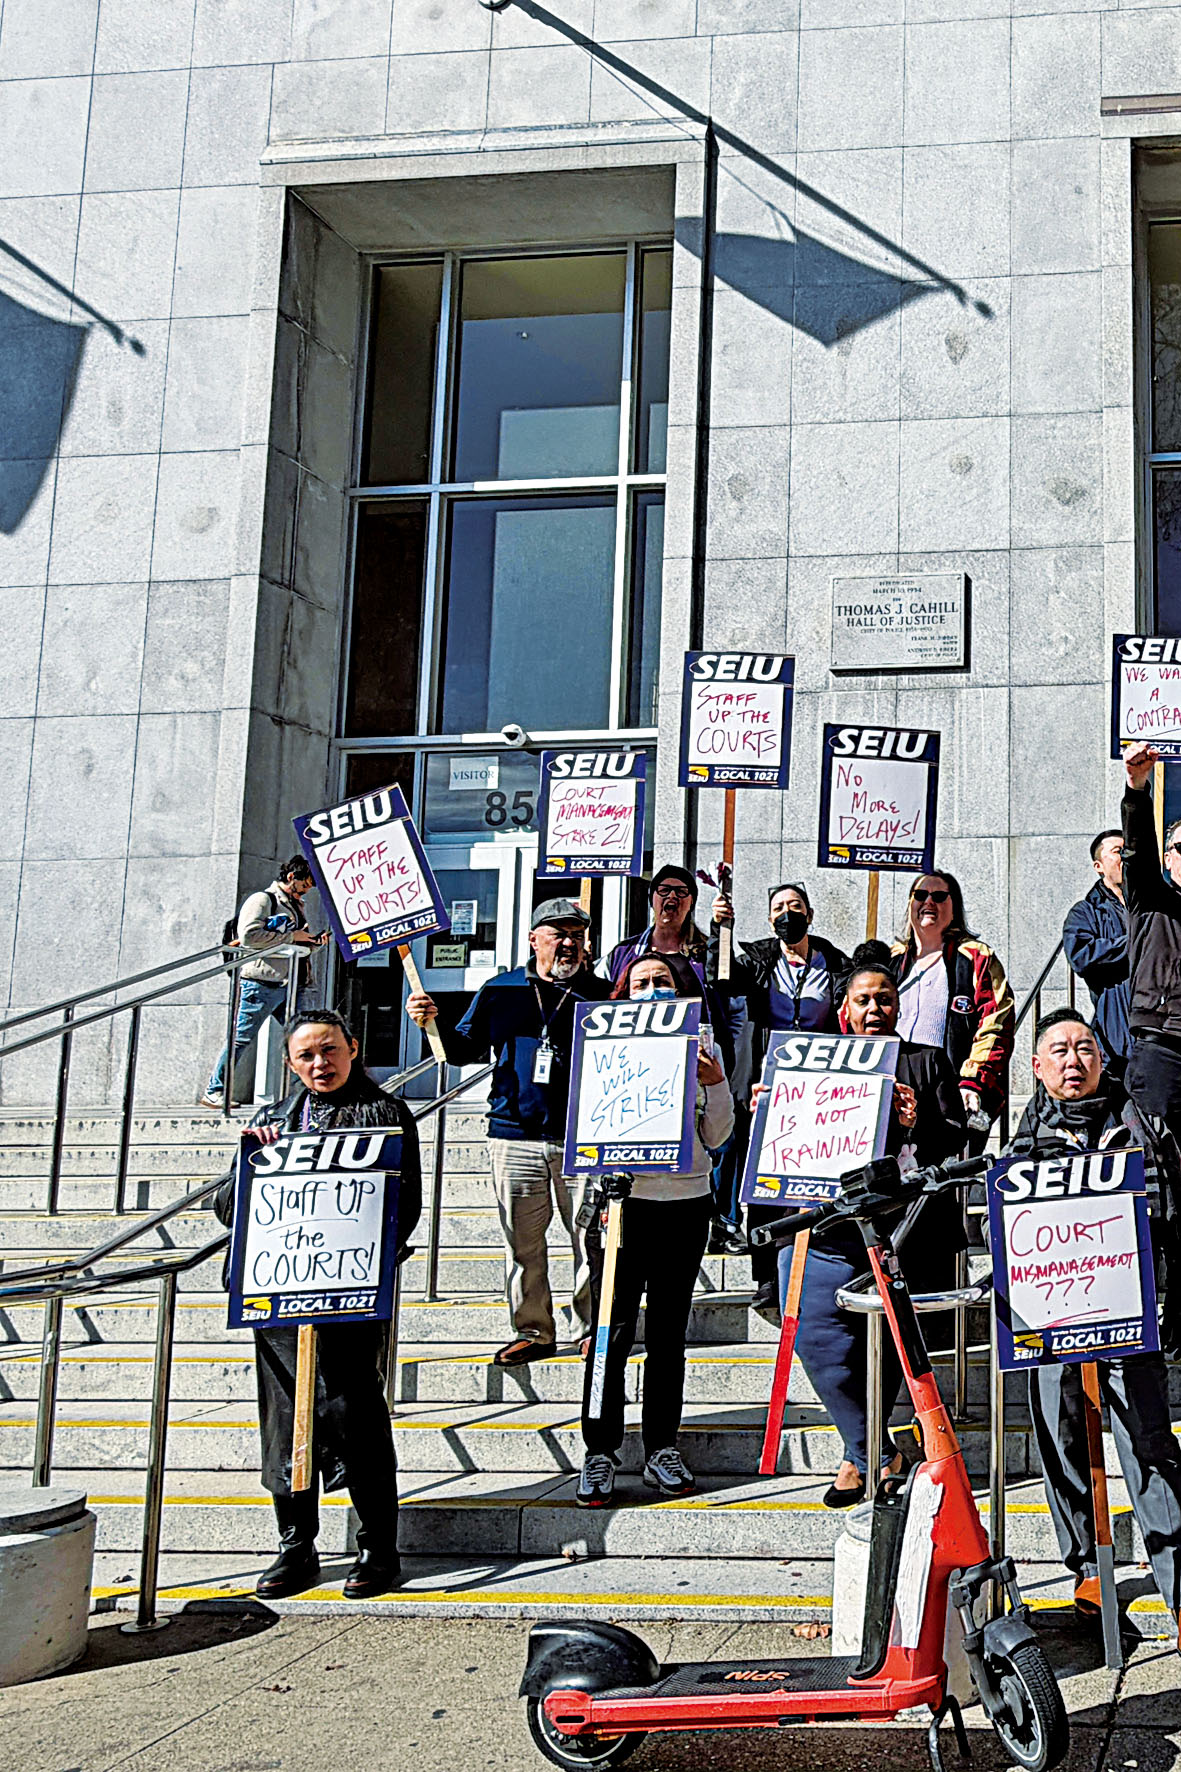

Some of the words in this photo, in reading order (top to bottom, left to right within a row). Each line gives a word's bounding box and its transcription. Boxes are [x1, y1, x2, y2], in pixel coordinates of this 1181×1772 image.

[835, 604, 891, 616] THOMAS
[895, 603, 903, 614] J
[910, 602, 958, 614] CAHILL
[847, 617, 876, 627] HALL
[880, 616, 895, 626] OF
[897, 615, 946, 626] JUSTICE
[694, 655, 783, 680] SEIU
[1125, 667, 1148, 683] WE
[697, 685, 757, 710] STAFF
[1150, 687, 1159, 701] A
[709, 709, 731, 723] UP
[737, 710, 770, 723] THE
[697, 727, 777, 758] COURTS
[834, 729, 928, 758] SEIU
[454, 770, 494, 780] VISITOR
[552, 753, 635, 778] SEIU
[714, 771, 750, 780] LOCAL
[754, 772, 778, 780] 1021
[552, 782, 617, 802] COURT
[852, 791, 899, 814] MORE
[310, 790, 392, 845] SEIU
[484, 791, 534, 827] 85
[838, 810, 920, 846] DELAYS!
[327, 840, 388, 880] STAFF
[570, 861, 605, 869] LOCAL
[856, 852, 893, 862] LOCAL
[898, 854, 922, 864] 1021
[343, 873, 364, 894] UP
[372, 857, 410, 885] THE
[344, 872, 424, 926] COURTS!
[376, 923, 411, 942] LOCAL
[413, 913, 436, 929] 1021
[586, 1002, 688, 1036] SEIU
[594, 1045, 630, 1074] WE
[776, 1038, 886, 1071] SEIU
[603, 1062, 650, 1095] WILL
[591, 1064, 680, 1136] STRIKE!
[774, 1082, 805, 1108] AN
[815, 1077, 876, 1106] EMAIL
[780, 1115, 797, 1132] IS
[816, 1106, 861, 1125] NOT
[255, 1134, 386, 1174] SEIU
[574, 1156, 598, 1166] SEIU
[603, 1150, 646, 1161] LOCAL
[650, 1150, 678, 1160] 1021
[761, 1126, 874, 1172] TRAINING
[1004, 1152, 1127, 1200] SEIU
[753, 1189, 780, 1199] SEIU
[786, 1184, 830, 1197] LOCAL
[256, 1181, 328, 1226] Staff
[280, 1226, 325, 1250] the
[1010, 1210, 1123, 1257] COURT
[253, 1242, 376, 1286] COURTS!
[279, 1298, 334, 1313] LOCAL
[339, 1296, 376, 1309] 1021
[1036, 1276, 1095, 1314] ???
[241, 1311, 271, 1321] SEIU
[1052, 1332, 1104, 1350] LOCAL
[1110, 1327, 1142, 1342] 1021
[1013, 1348, 1043, 1360] SEIU
